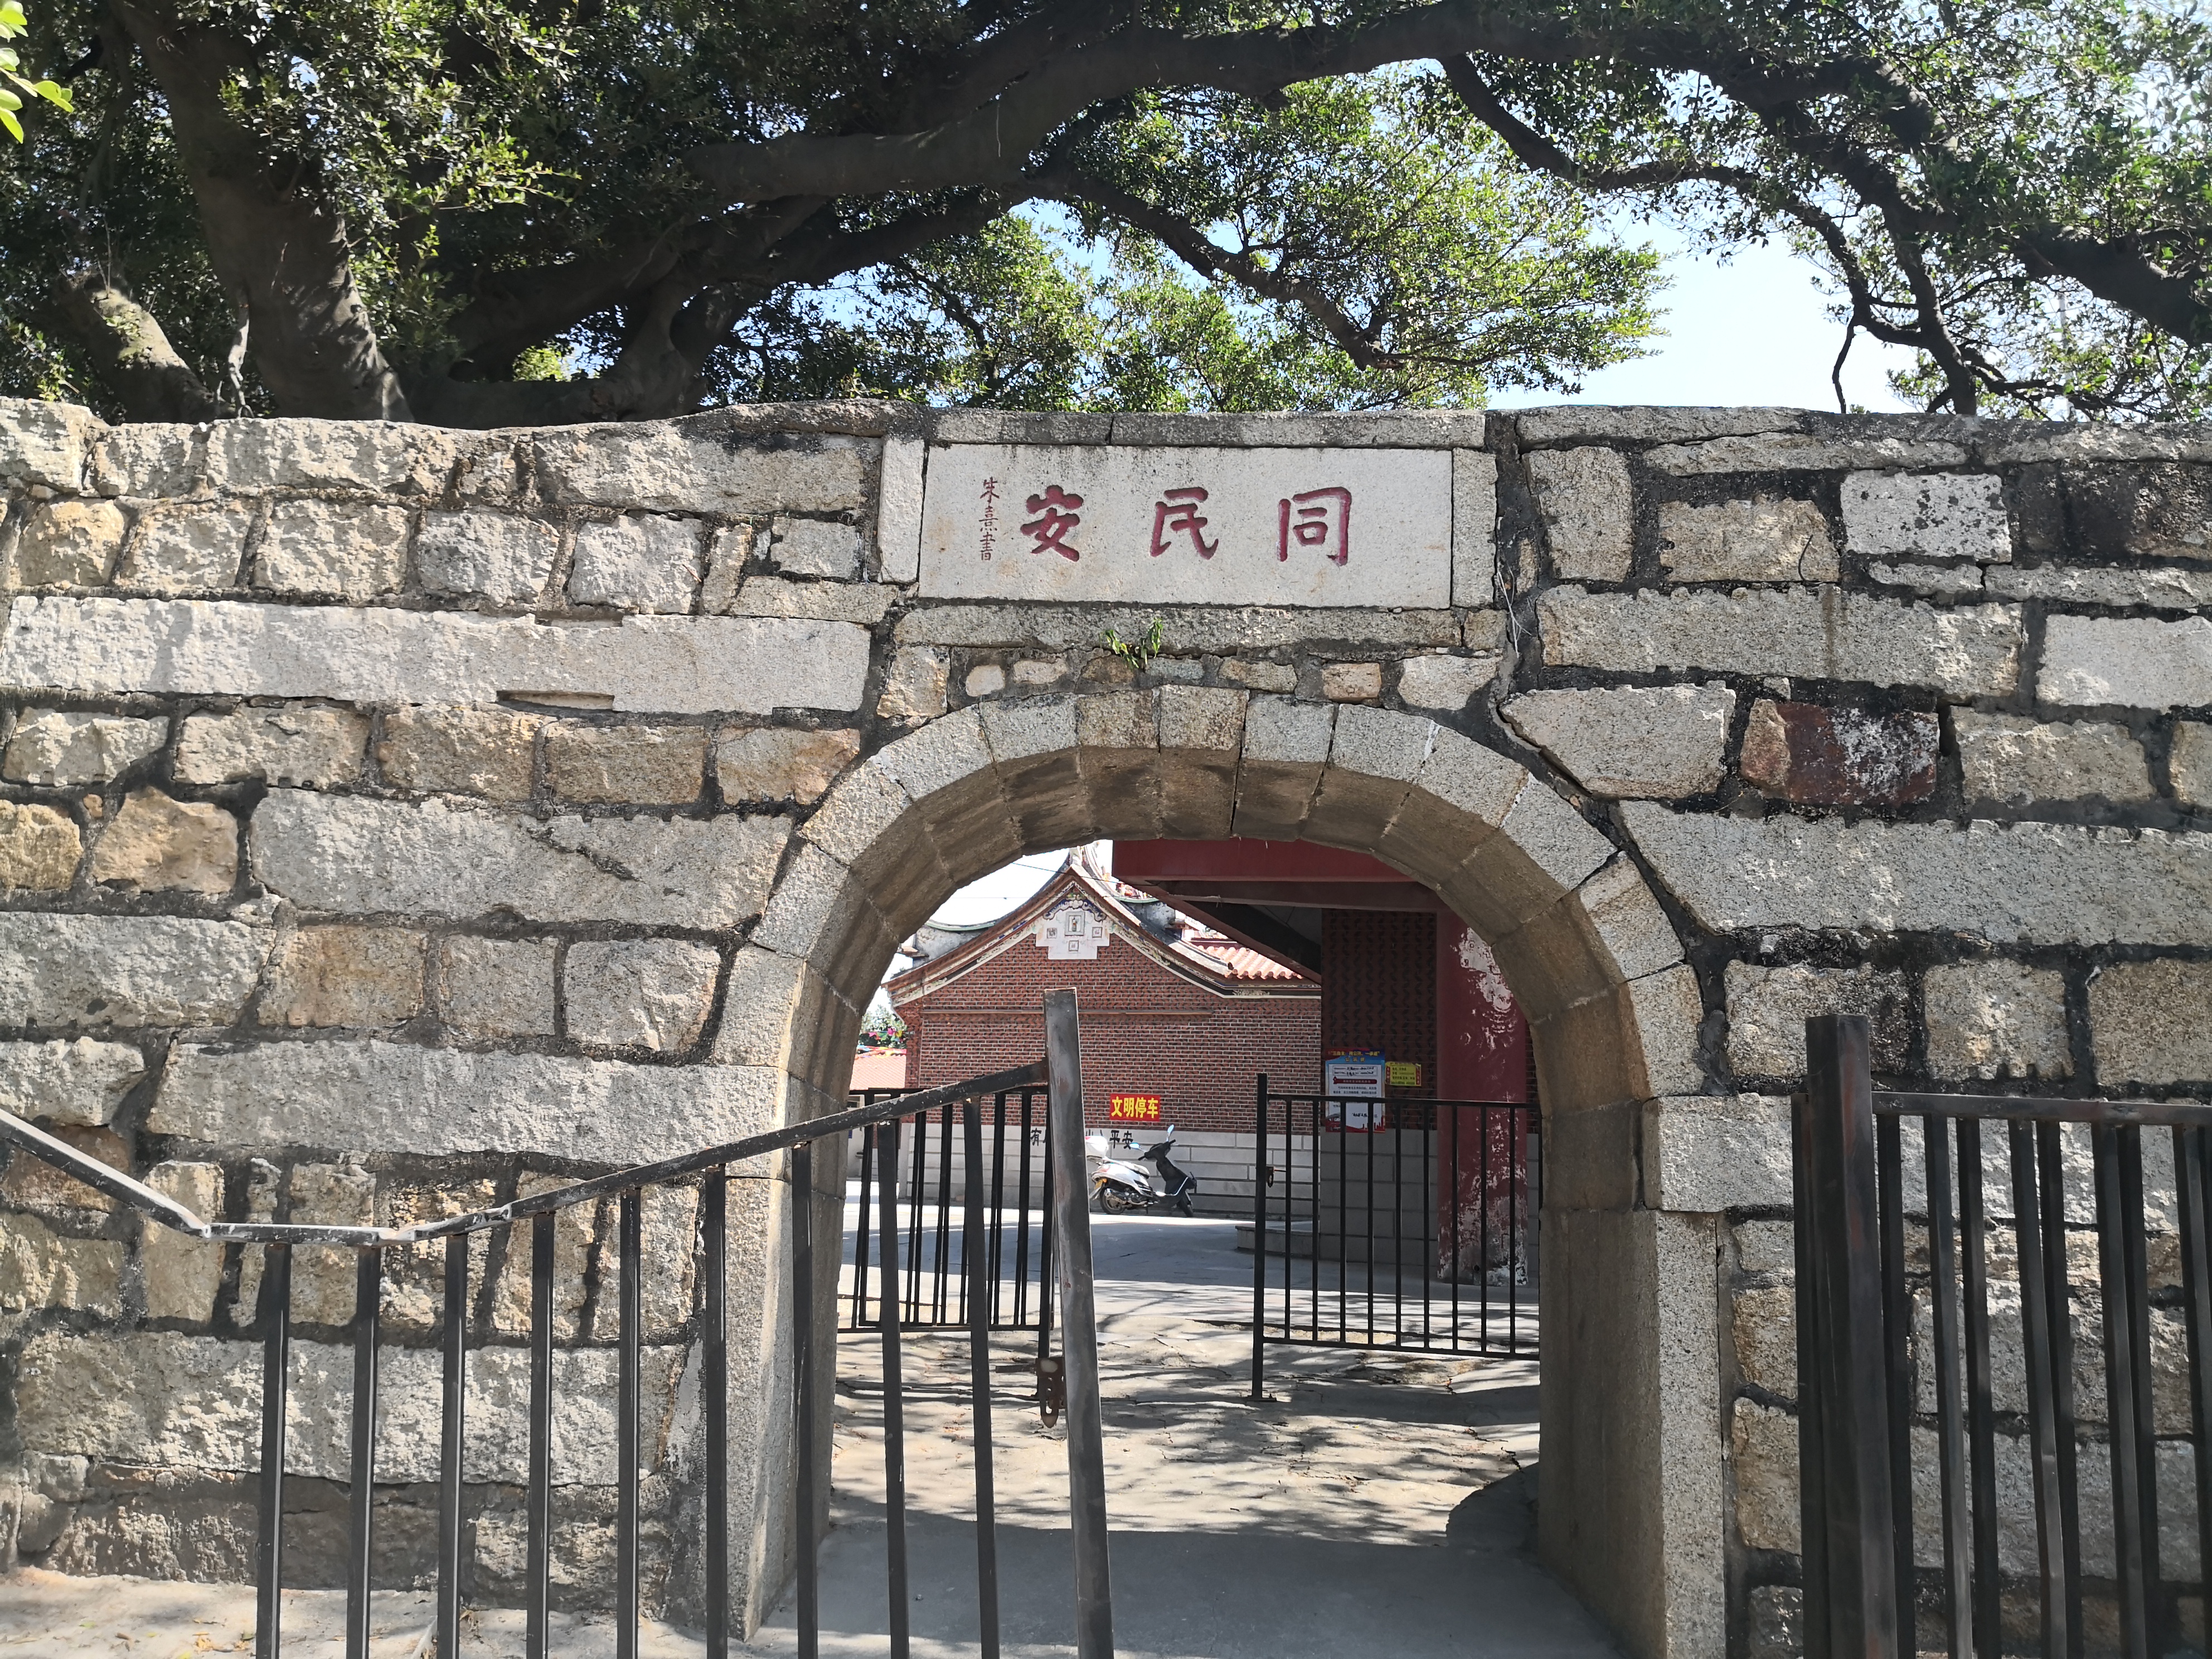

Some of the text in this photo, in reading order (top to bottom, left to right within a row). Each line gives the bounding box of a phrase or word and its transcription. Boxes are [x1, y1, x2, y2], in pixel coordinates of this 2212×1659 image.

[978, 476, 1000, 561] 朱熹書
[1111, 1096, 1159, 1119] 文明停车
